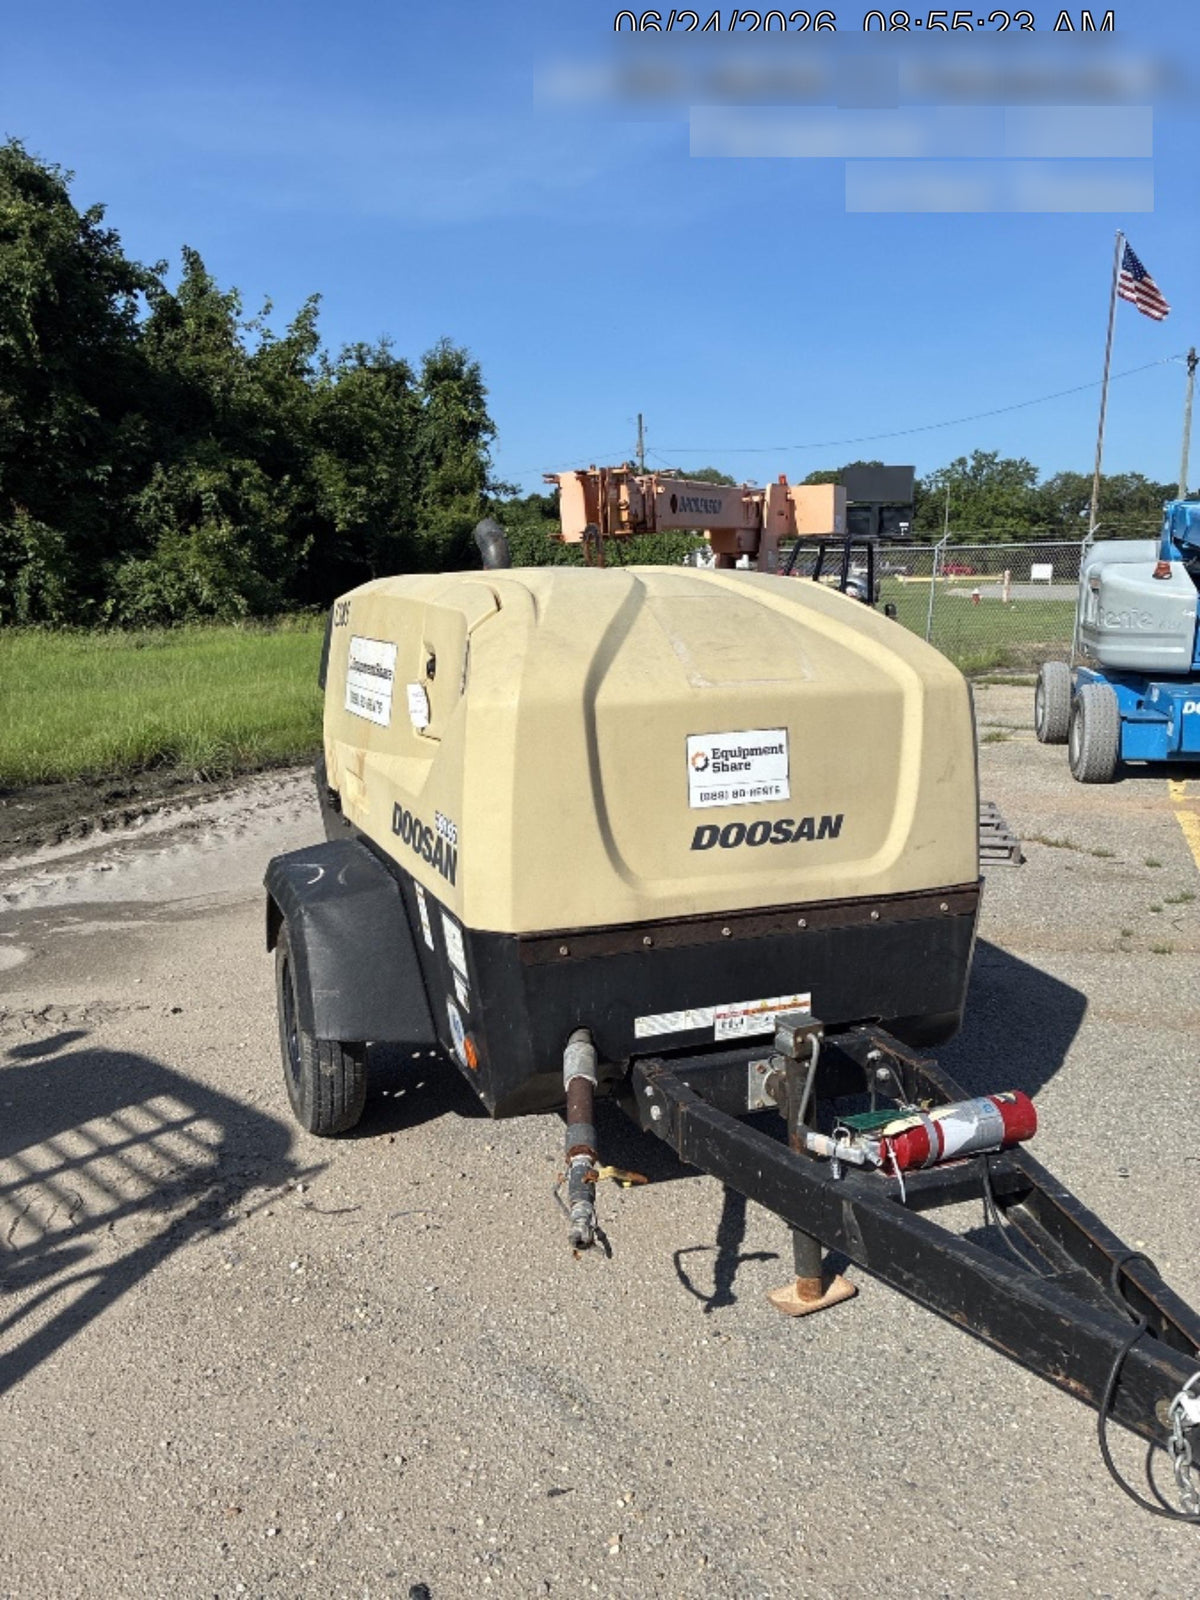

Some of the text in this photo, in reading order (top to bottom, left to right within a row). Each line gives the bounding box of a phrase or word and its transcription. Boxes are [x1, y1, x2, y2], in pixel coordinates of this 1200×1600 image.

[711, 743, 784, 761] Equipment
[712, 761, 751, 773] Share
[392, 801, 456, 885] DOOSAN
[690, 813, 844, 850] DOOSAN
